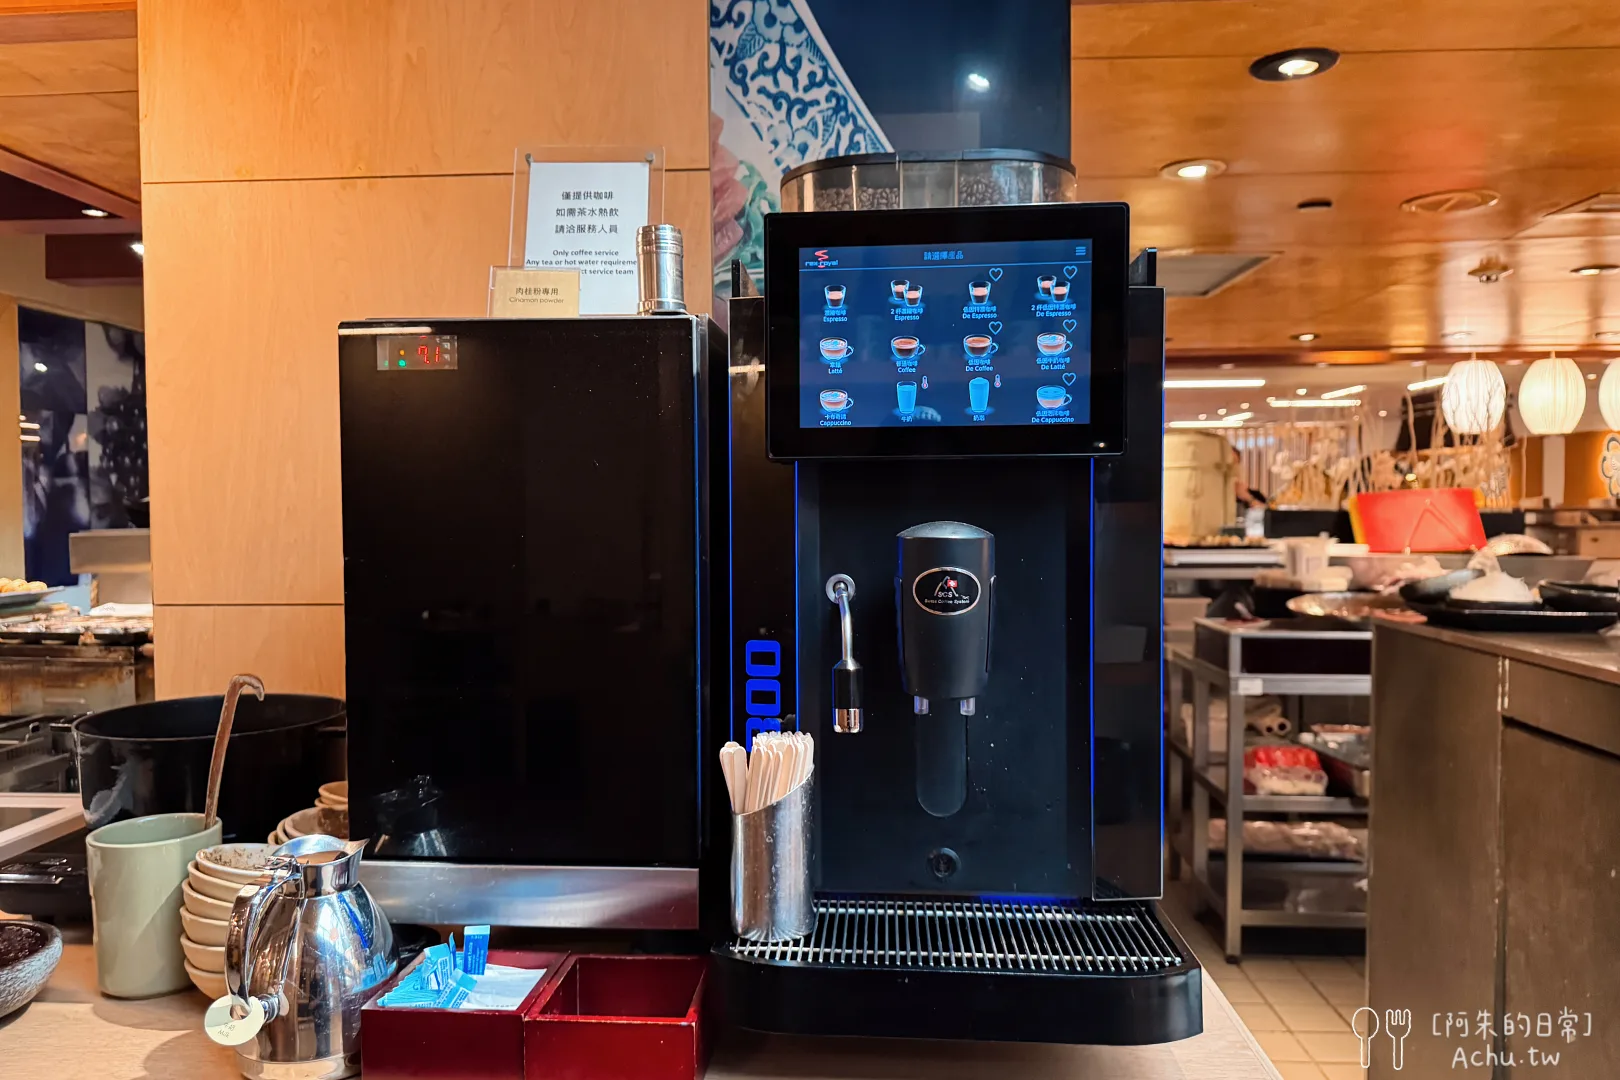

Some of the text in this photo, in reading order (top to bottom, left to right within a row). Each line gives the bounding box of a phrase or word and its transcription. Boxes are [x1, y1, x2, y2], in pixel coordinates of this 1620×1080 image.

[562, 191, 614, 200] 僅提供咖啡
[556, 207, 619, 217] 如需茶水熱飲
[555, 224, 618, 234] 請洽服務人員
[553, 249, 569, 257] Only
[600, 259, 637, 267] requireme
[515, 287, 559, 295] 肉桂粉專用
[971, 312, 998, 320] Espresso
[1045, 310, 1072, 318] Espresso
[819, 419, 852, 427] Cappuccino
[1040, 416, 1075, 424] Cappuccino
